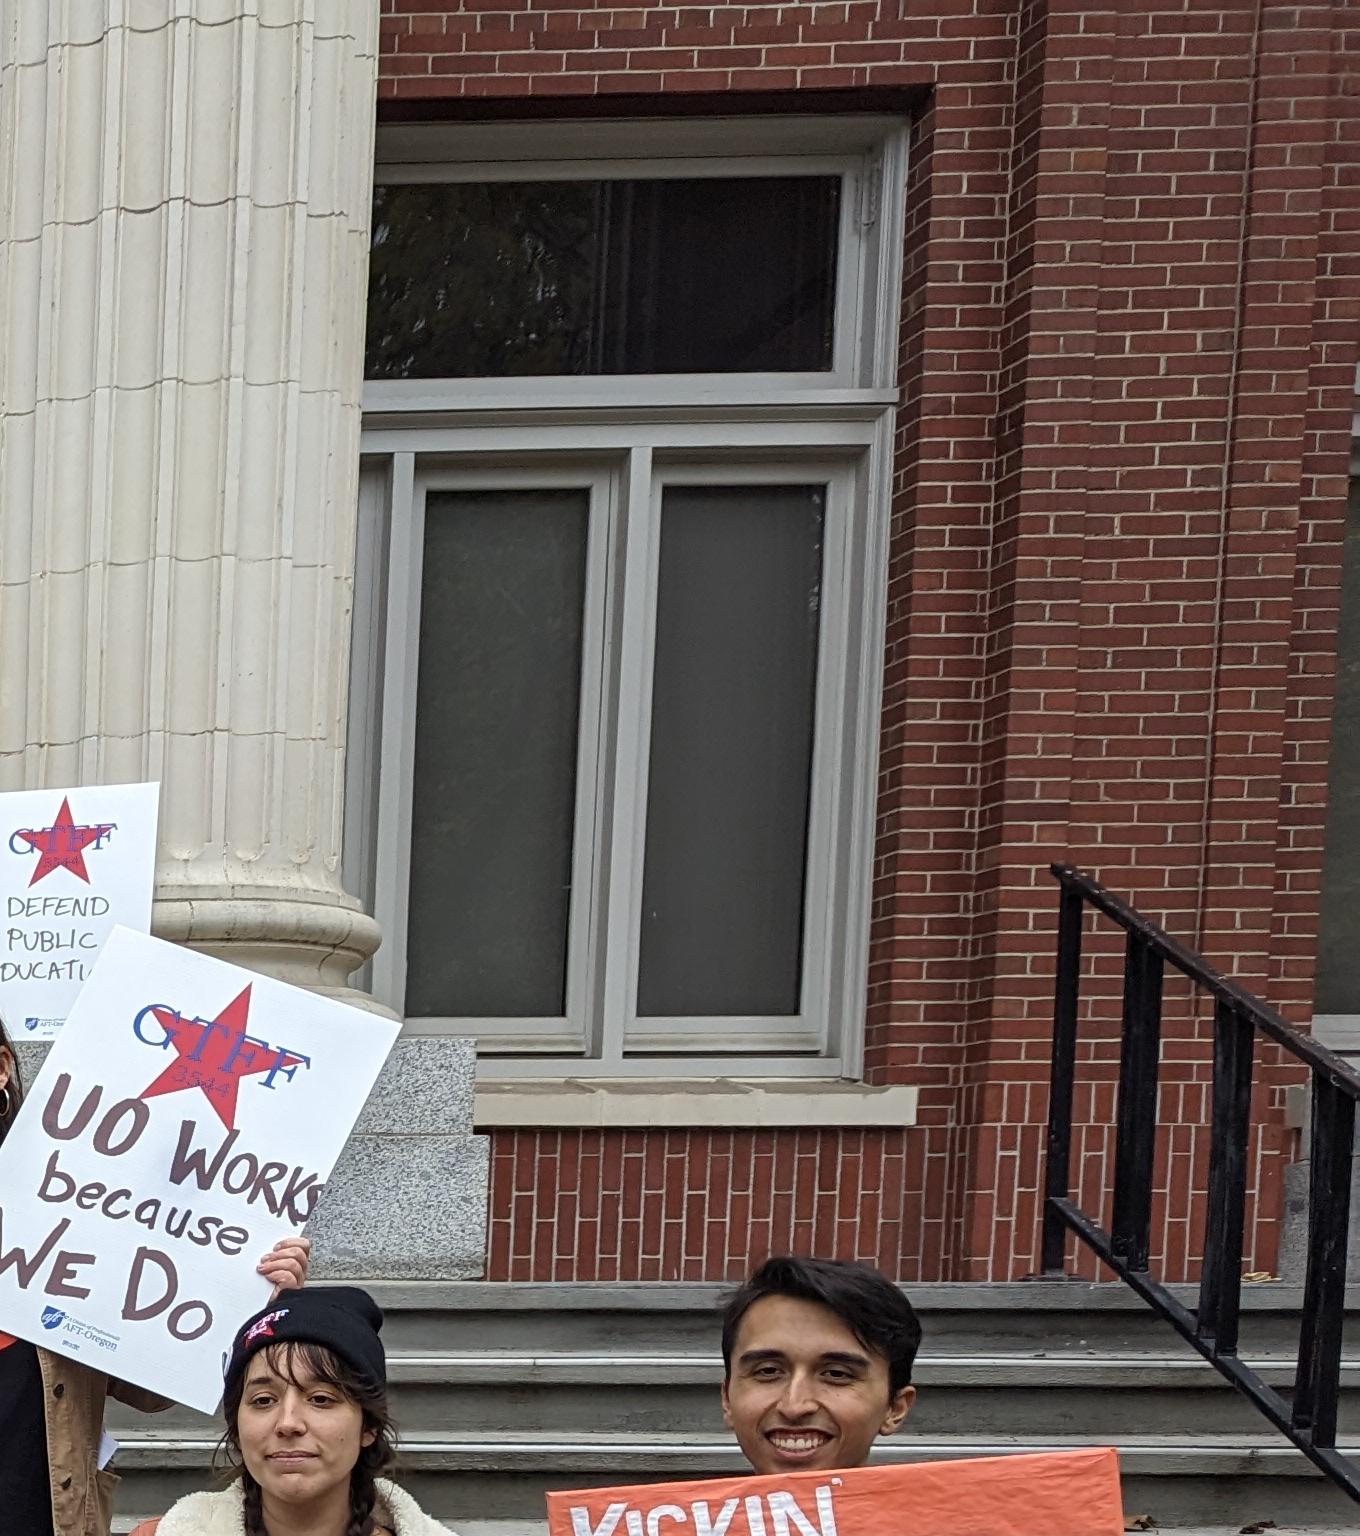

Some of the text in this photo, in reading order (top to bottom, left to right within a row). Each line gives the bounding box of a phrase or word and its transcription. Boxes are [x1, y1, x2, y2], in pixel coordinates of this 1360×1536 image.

[7, 896, 110, 918] DEFEND
[7, 928, 98, 952] PUBLIC
[133, 1004, 311, 1090] GTFF
[41, 1073, 149, 1157] UO
[39, 1150, 249, 1256] because
